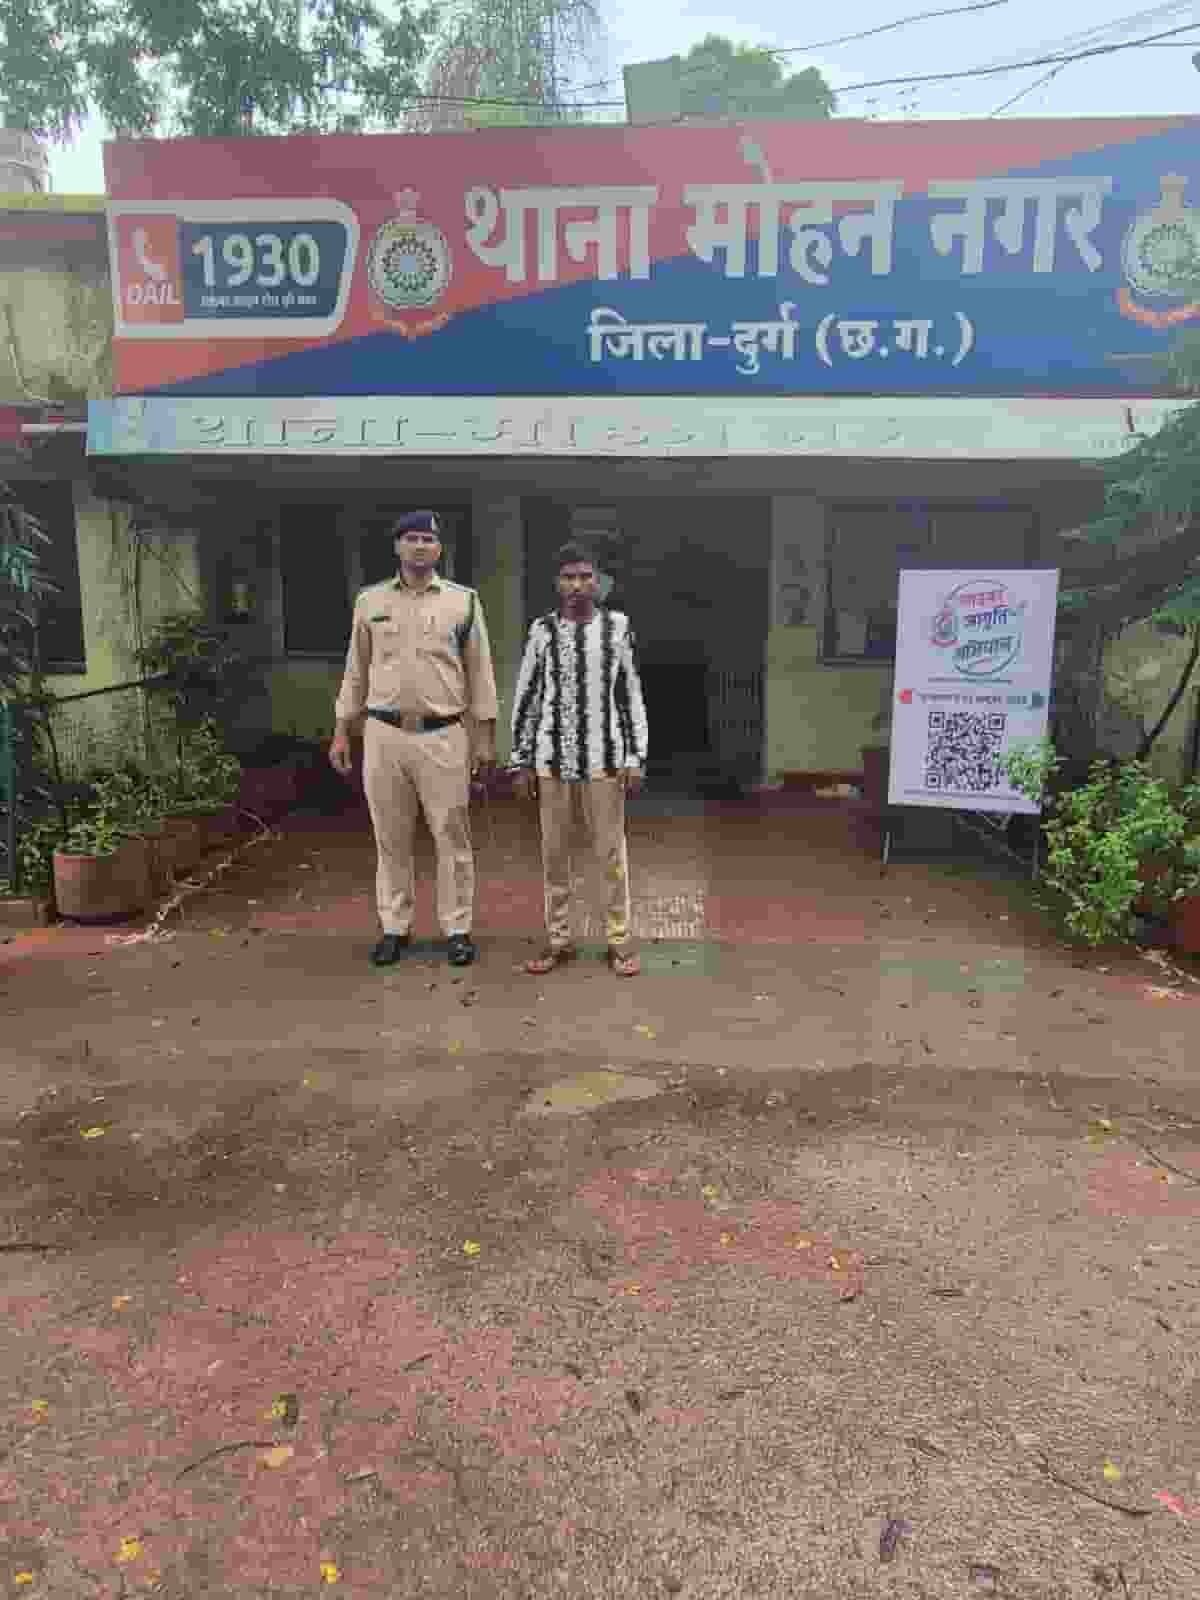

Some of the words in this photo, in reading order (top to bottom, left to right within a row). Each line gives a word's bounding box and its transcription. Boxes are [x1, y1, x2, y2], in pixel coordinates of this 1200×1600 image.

[463, 182, 657, 281] थाना
[683, 136, 905, 284] मोहन
[927, 175, 1113, 274] नगर
[191, 232, 322, 288] 1930
[815, 311, 976, 368] (छ.ग.)
